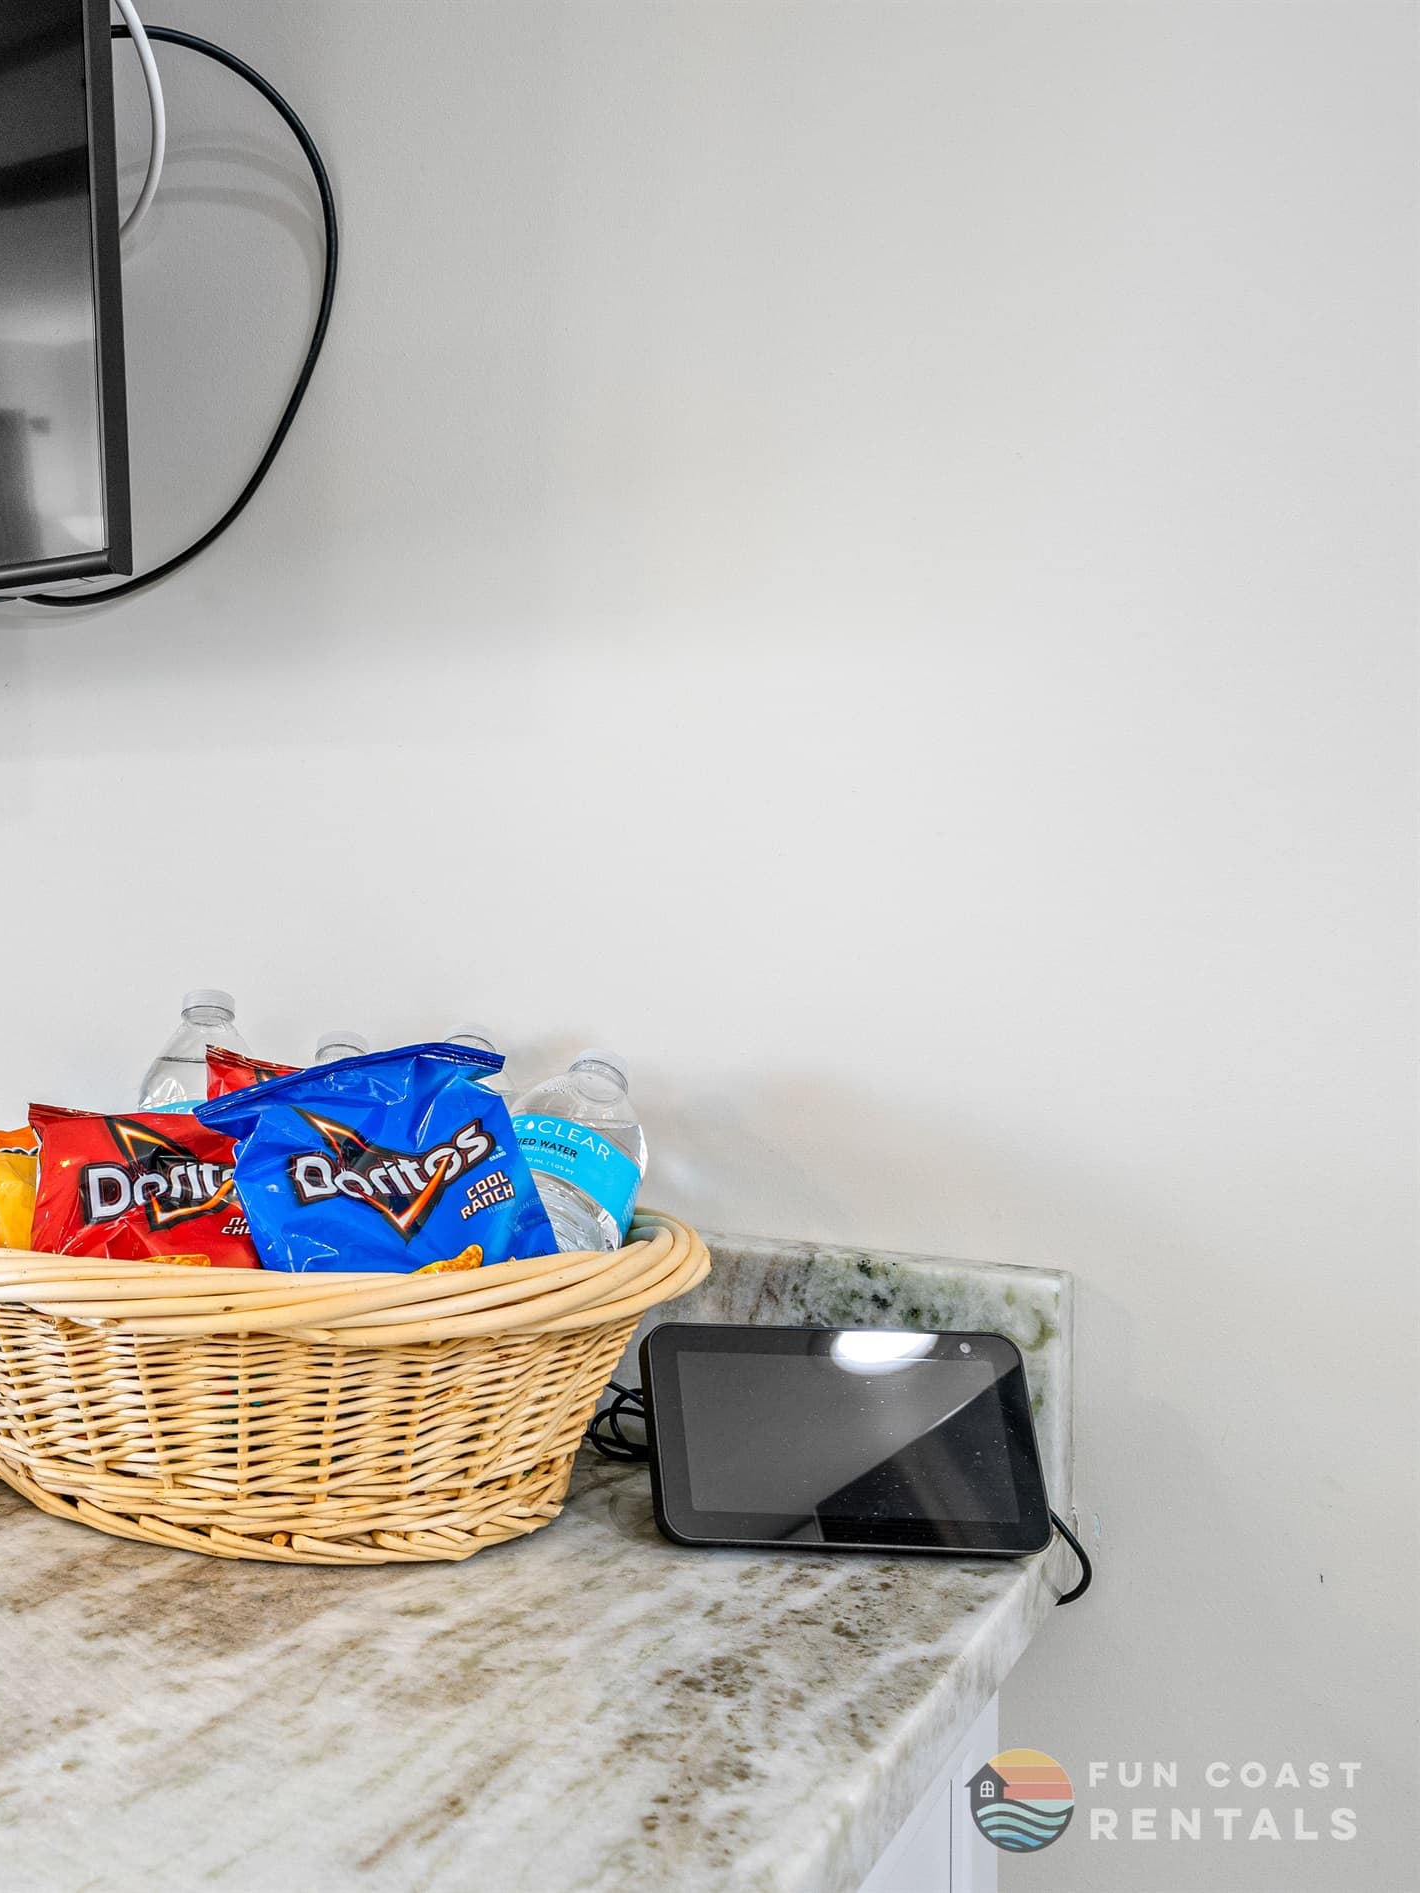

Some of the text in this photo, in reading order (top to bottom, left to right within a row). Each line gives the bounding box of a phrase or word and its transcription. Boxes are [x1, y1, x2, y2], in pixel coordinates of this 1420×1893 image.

[538, 1120, 611, 1161] CLEAR
[540, 1139, 579, 1158] WATER
[294, 1123, 489, 1199] Doritos
[460, 1184, 516, 1220] RANCH
[466, 1170, 509, 1200] COOL
